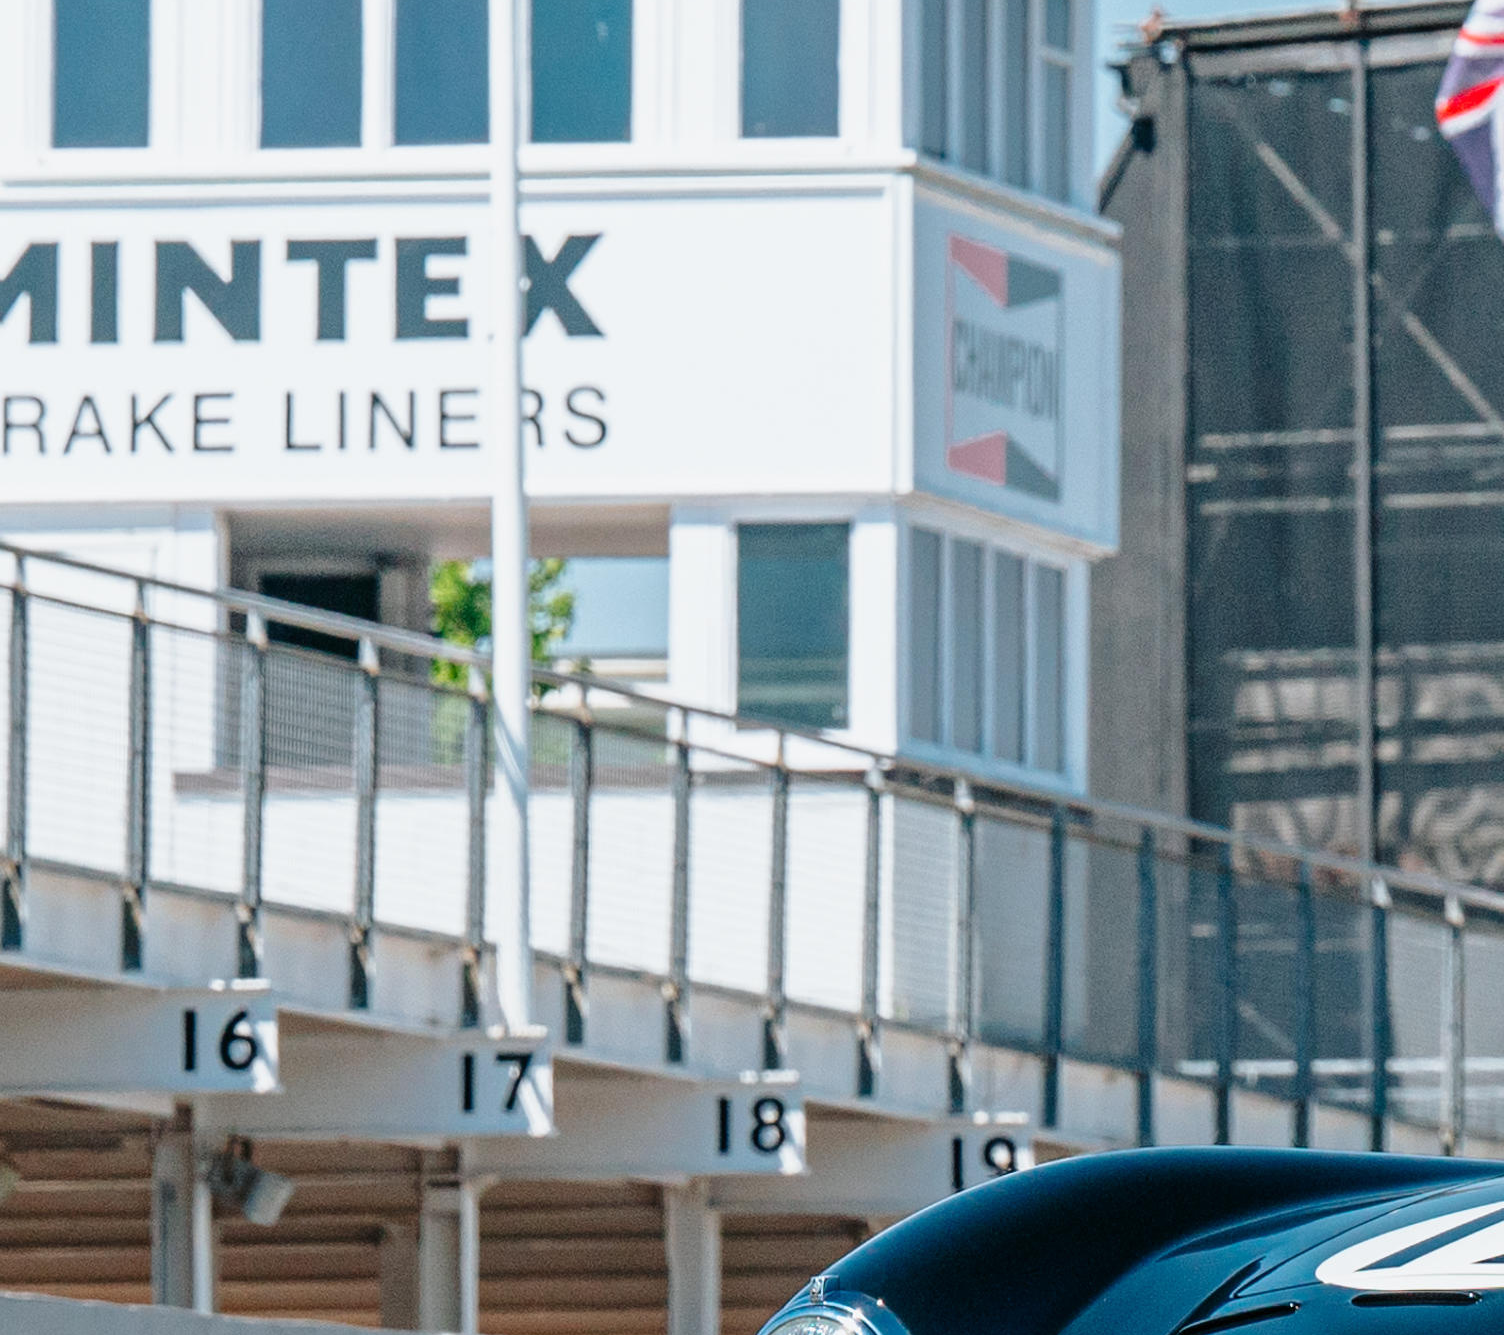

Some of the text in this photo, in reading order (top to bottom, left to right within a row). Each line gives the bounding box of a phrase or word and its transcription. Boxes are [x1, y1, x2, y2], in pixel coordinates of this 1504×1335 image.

[283, 384, 609, 453] LINERS
[183, 1007, 258, 1073] 16
[461, 1051, 534, 1114] 17
[716, 1095, 787, 1155] 18
[951, 1136, 1017, 1191] 19
